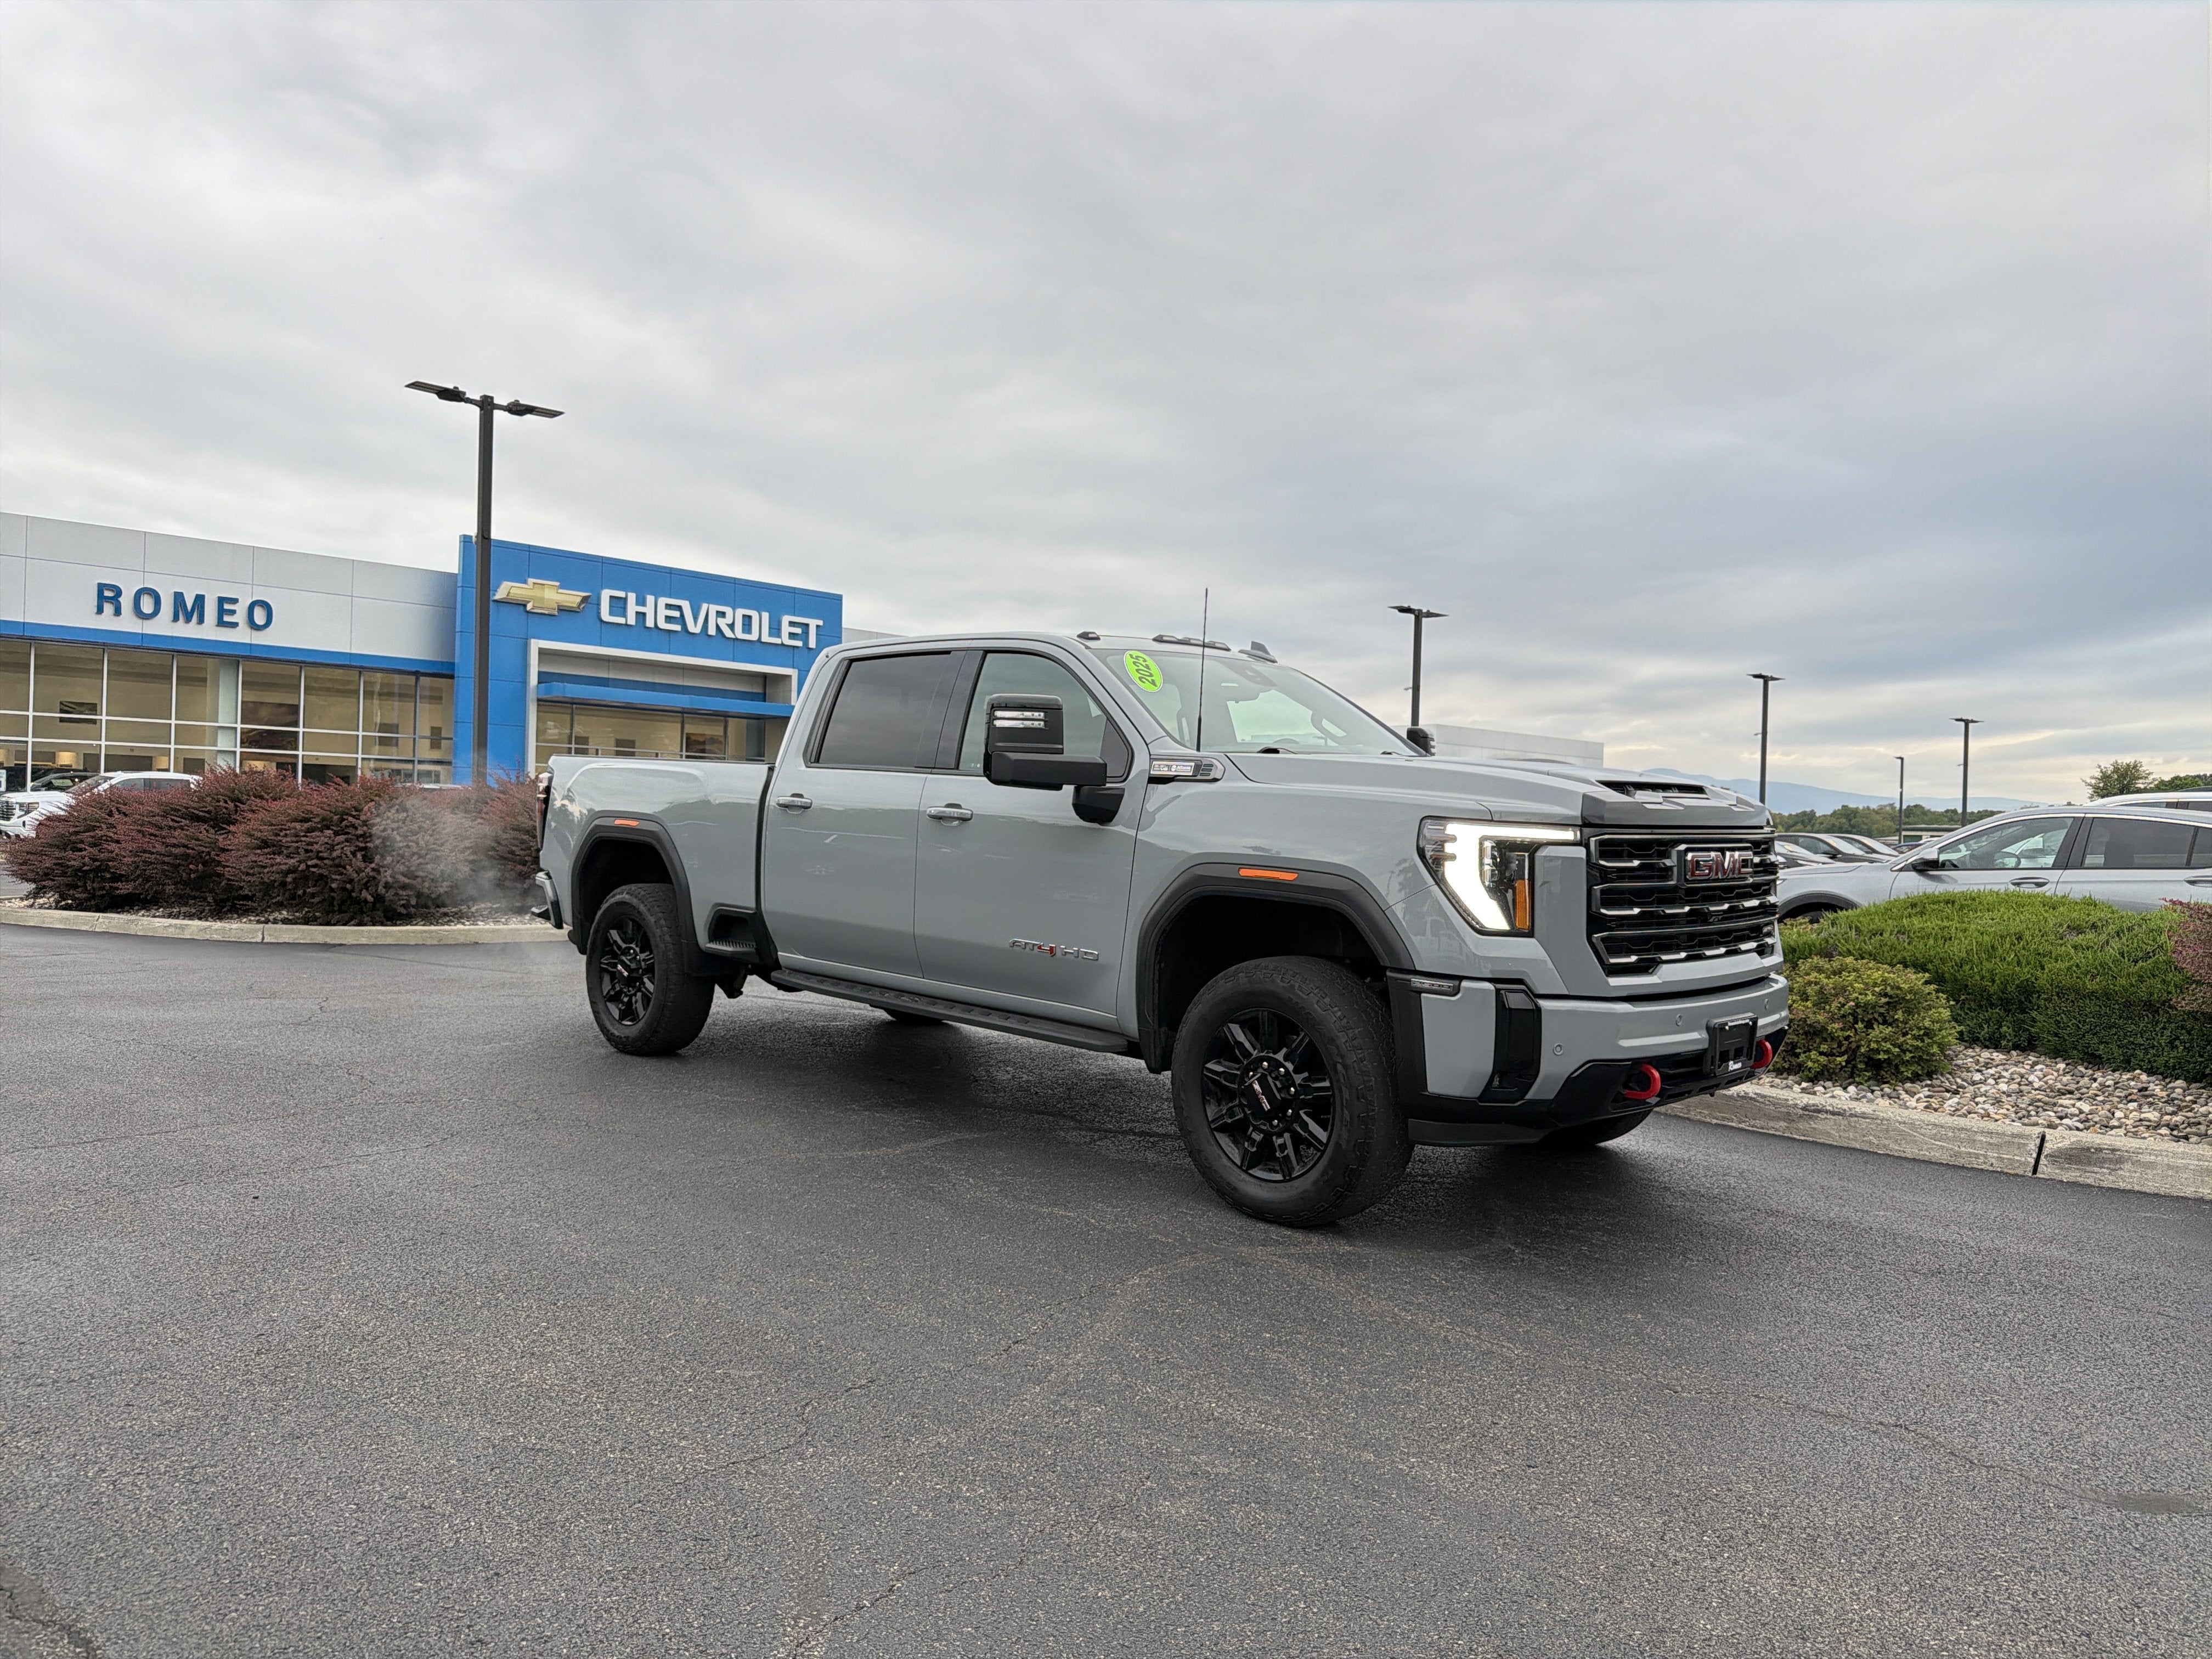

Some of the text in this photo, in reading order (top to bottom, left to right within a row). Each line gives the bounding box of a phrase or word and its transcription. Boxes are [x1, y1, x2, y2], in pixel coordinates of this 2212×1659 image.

[95, 582, 273, 631] ROMEO
[599, 589, 824, 650] CHEVROLET
[1128, 653, 1158, 688] 2025
[1687, 851, 1753, 880] GMC
[1008, 938, 1099, 961] AT4 HD
